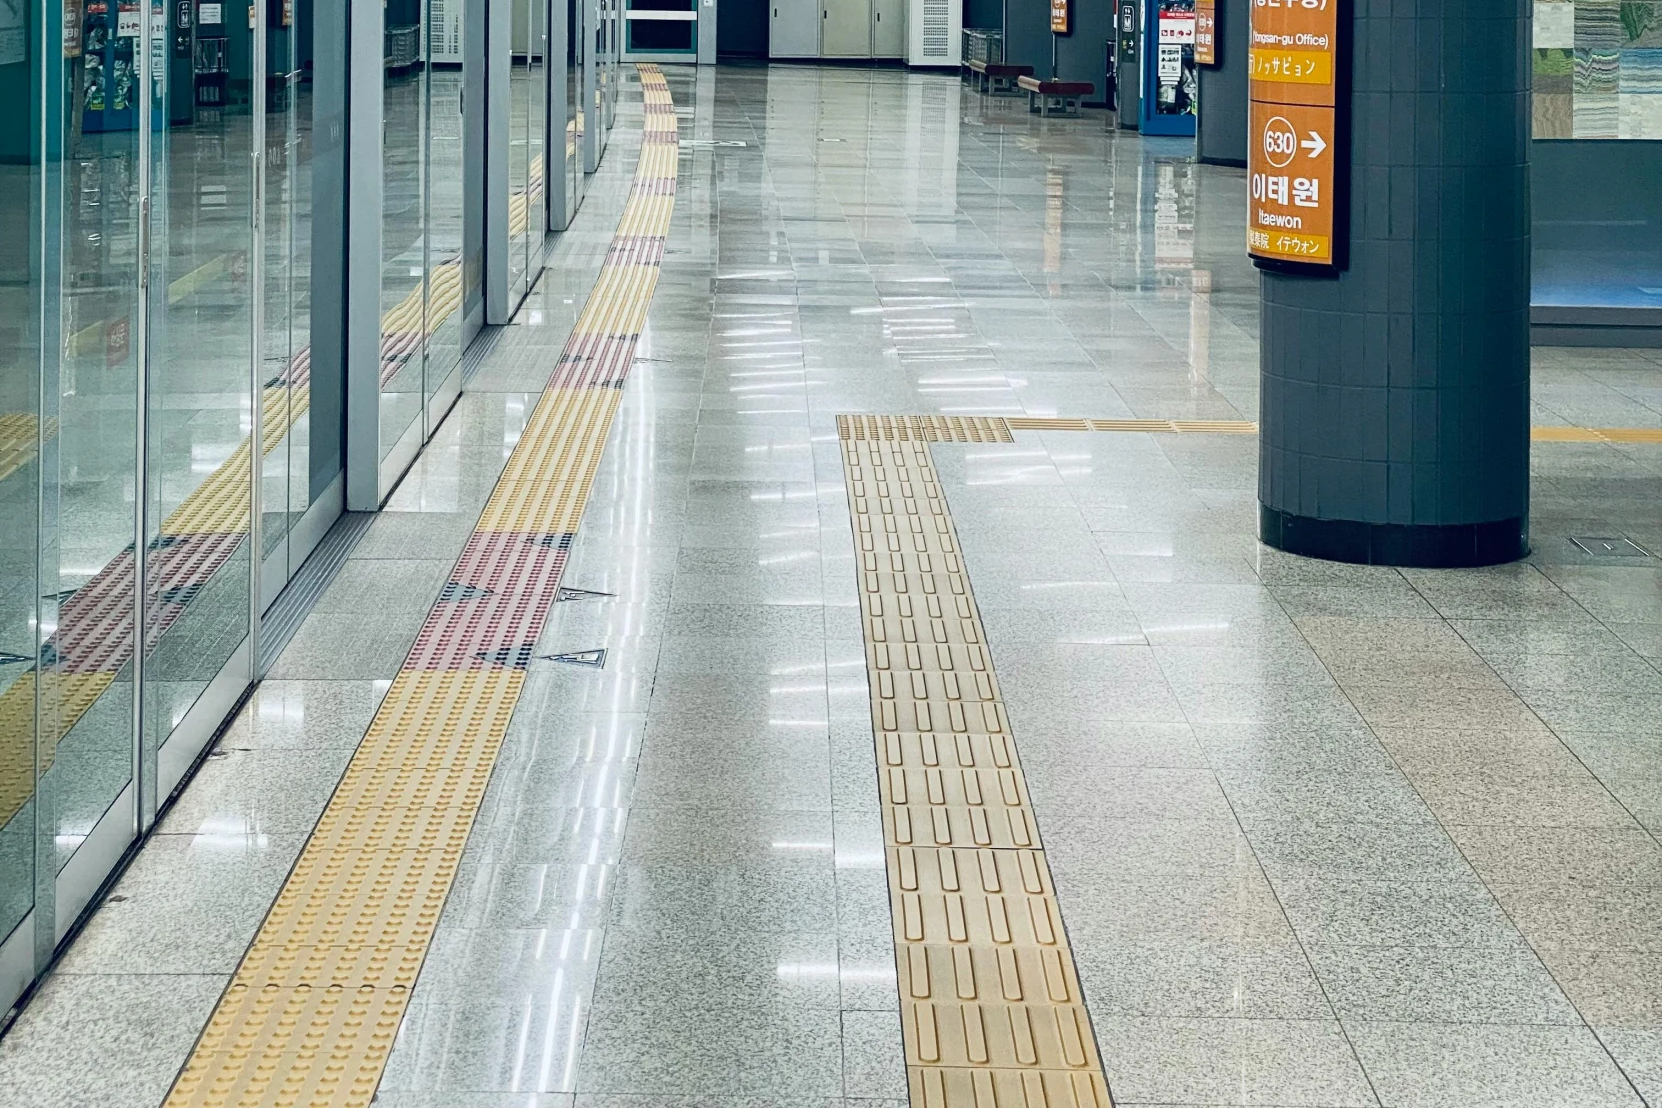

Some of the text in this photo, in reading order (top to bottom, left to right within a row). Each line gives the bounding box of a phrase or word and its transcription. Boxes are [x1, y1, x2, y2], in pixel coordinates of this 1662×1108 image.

[1295, 33, 1329, 50] Office)
[1266, 130, 1294, 154] 630
[1252, 173, 1319, 208] 이태원
[1258, 208, 1302, 229] Itaewon
